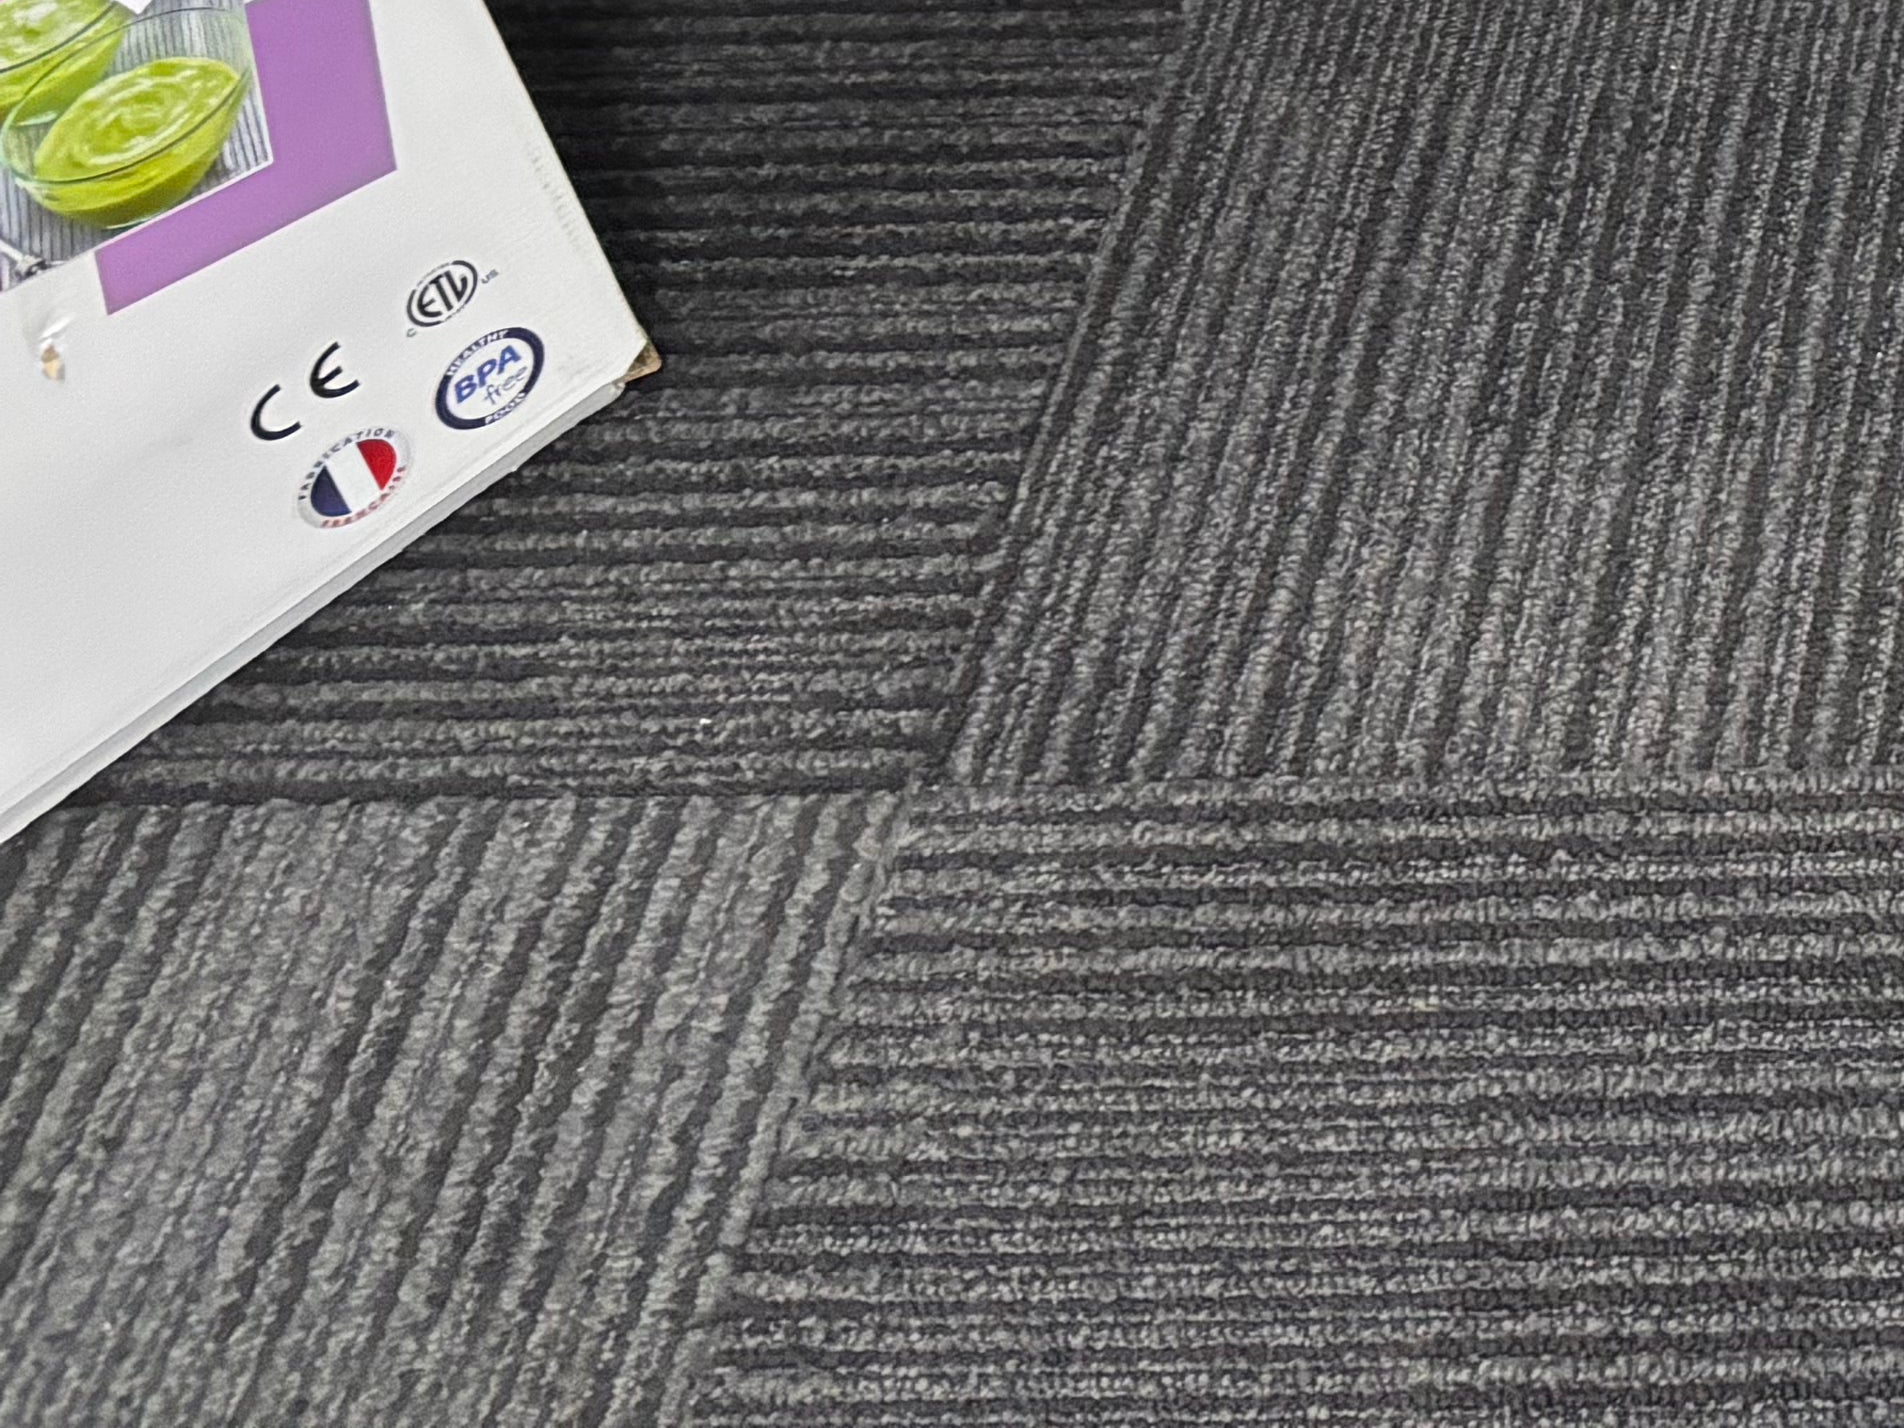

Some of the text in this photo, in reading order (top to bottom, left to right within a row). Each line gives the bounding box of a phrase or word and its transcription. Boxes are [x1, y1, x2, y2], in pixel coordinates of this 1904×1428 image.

[417, 270, 468, 318] ETL
[454, 345, 522, 404] BPA
[484, 366, 528, 406] free
